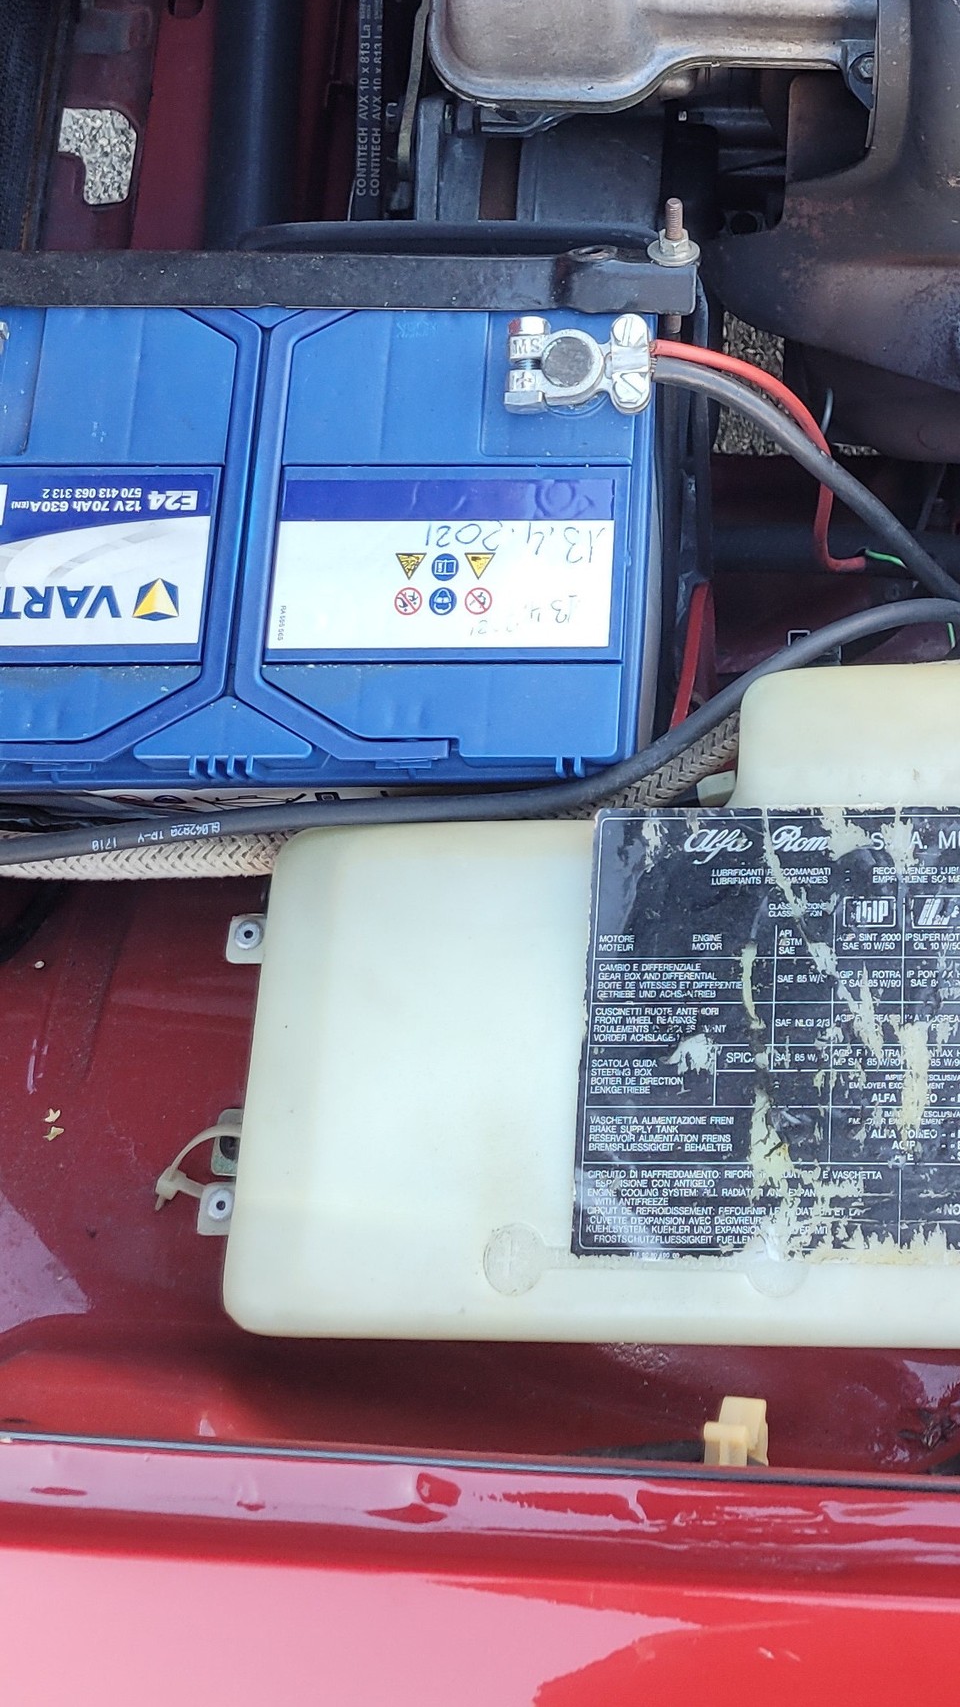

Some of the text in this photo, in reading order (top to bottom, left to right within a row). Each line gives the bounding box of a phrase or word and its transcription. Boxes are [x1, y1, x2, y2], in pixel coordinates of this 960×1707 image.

[360, 24, 371, 39] La
[360, 42, 371, 64] 813
[359, 78, 370, 91] 10
[358, 95, 369, 120] AVX
[370, 95, 382, 196] CONTITECH AVX
[356, 127, 368, 196] CONTITECH
[42, 488, 142, 499] 570 413 063 313 2
[148, 490, 199, 511] E24
[73, 500, 110, 512] 70Ah
[113, 500, 142, 512] 12V
[0, 585, 122, 619] VART
[684, 828, 753, 865] Alfa
[711, 868, 764, 877] LUBRIFICANTI
[711, 876, 762, 885] LUBRIFIANTS
[599, 934, 722, 943] MOTORE ENGINE
[858, 933, 901, 941] SINT 2000
[598, 943, 723, 952] MOTEUR MOTOR
[842, 942, 896, 950] SAE 10 W/50
[778, 947, 796, 955] SAE
[598, 963, 702, 972] CAMBIO E DIFFERENZIALE
[598, 972, 717, 981] GEAR BOX AND DIFFERENTIAL
[777, 975, 794, 983] SAE
[872, 970, 901, 979] ROTRA
[597, 981, 690, 989] BOITE DE VITESSES ET
[879, 979, 901, 988] W/90
[910, 979, 928, 988] SAE
[597, 990, 657, 999] GETRIEBE UND
[595, 1008, 673, 1016] CUSCINETTI RUOTE
[594, 1016, 623, 1025] FRONT
[625, 1016, 653, 1025] WHEEL
[794, 1018, 815, 1027] NLGI
[816, 1018, 831, 1027] 2/3
[593, 1025, 649, 1033] ROULEMENTS
[593, 1033, 627, 1042] VORDER
[726, 1052, 756, 1064] SPIC
[794, 1054, 805, 1062] 85
[866, 1058, 878, 1067] 85
[879, 1058, 900, 1067] W/90
[591, 1059, 658, 1068] SCATOLA GUIDA
[590, 1068, 653, 1076] STEERING BOX
[625, 1077, 637, 1085] DE
[640, 1077, 684, 1085] DIRECTION
[590, 1086, 651, 1094] LENKGETRIEBE
[871, 1093, 897, 1103] ALFA
[589, 1116, 734, 1125] VASCHETTA ALIMENTAZIONE FRENI
[589, 1125, 679, 1134] BRAKE SUPPLY TANK
[588, 1134, 731, 1143] RESERVOIR ALIMENTATION FREINS
[588, 1143, 733, 1152] BREMSFLUESSIGKEIT BEHAELTER
[587, 1170, 626, 1179] CIRCUITO
[630, 1170, 638, 1179] DI
[641, 1170, 721, 1179] RAFFREDDAMENTO:
[822, 1170, 829, 1179] E
[831, 1170, 883, 1179] VASCHETTA
[651, 1179, 715, 1188] CON ANTIGELO
[620, 1188, 659, 1197] COOLING
[661, 1188, 699, 1197] SYSTEM:
[594, 1197, 669, 1206] WITH ANTIFREEZE
[586, 1207, 715, 1215] CIRCUIT DE REFROIDISSEMENT:
[589, 1216, 712, 1225] CUVETTE D'EXPANSION AVEC
[585, 1225, 712, 1233] KUEHLSYSTEM: KUEHLER UND
[593, 1235, 713, 1244] FROSTSCHUTZFLUESSIGKEIT
